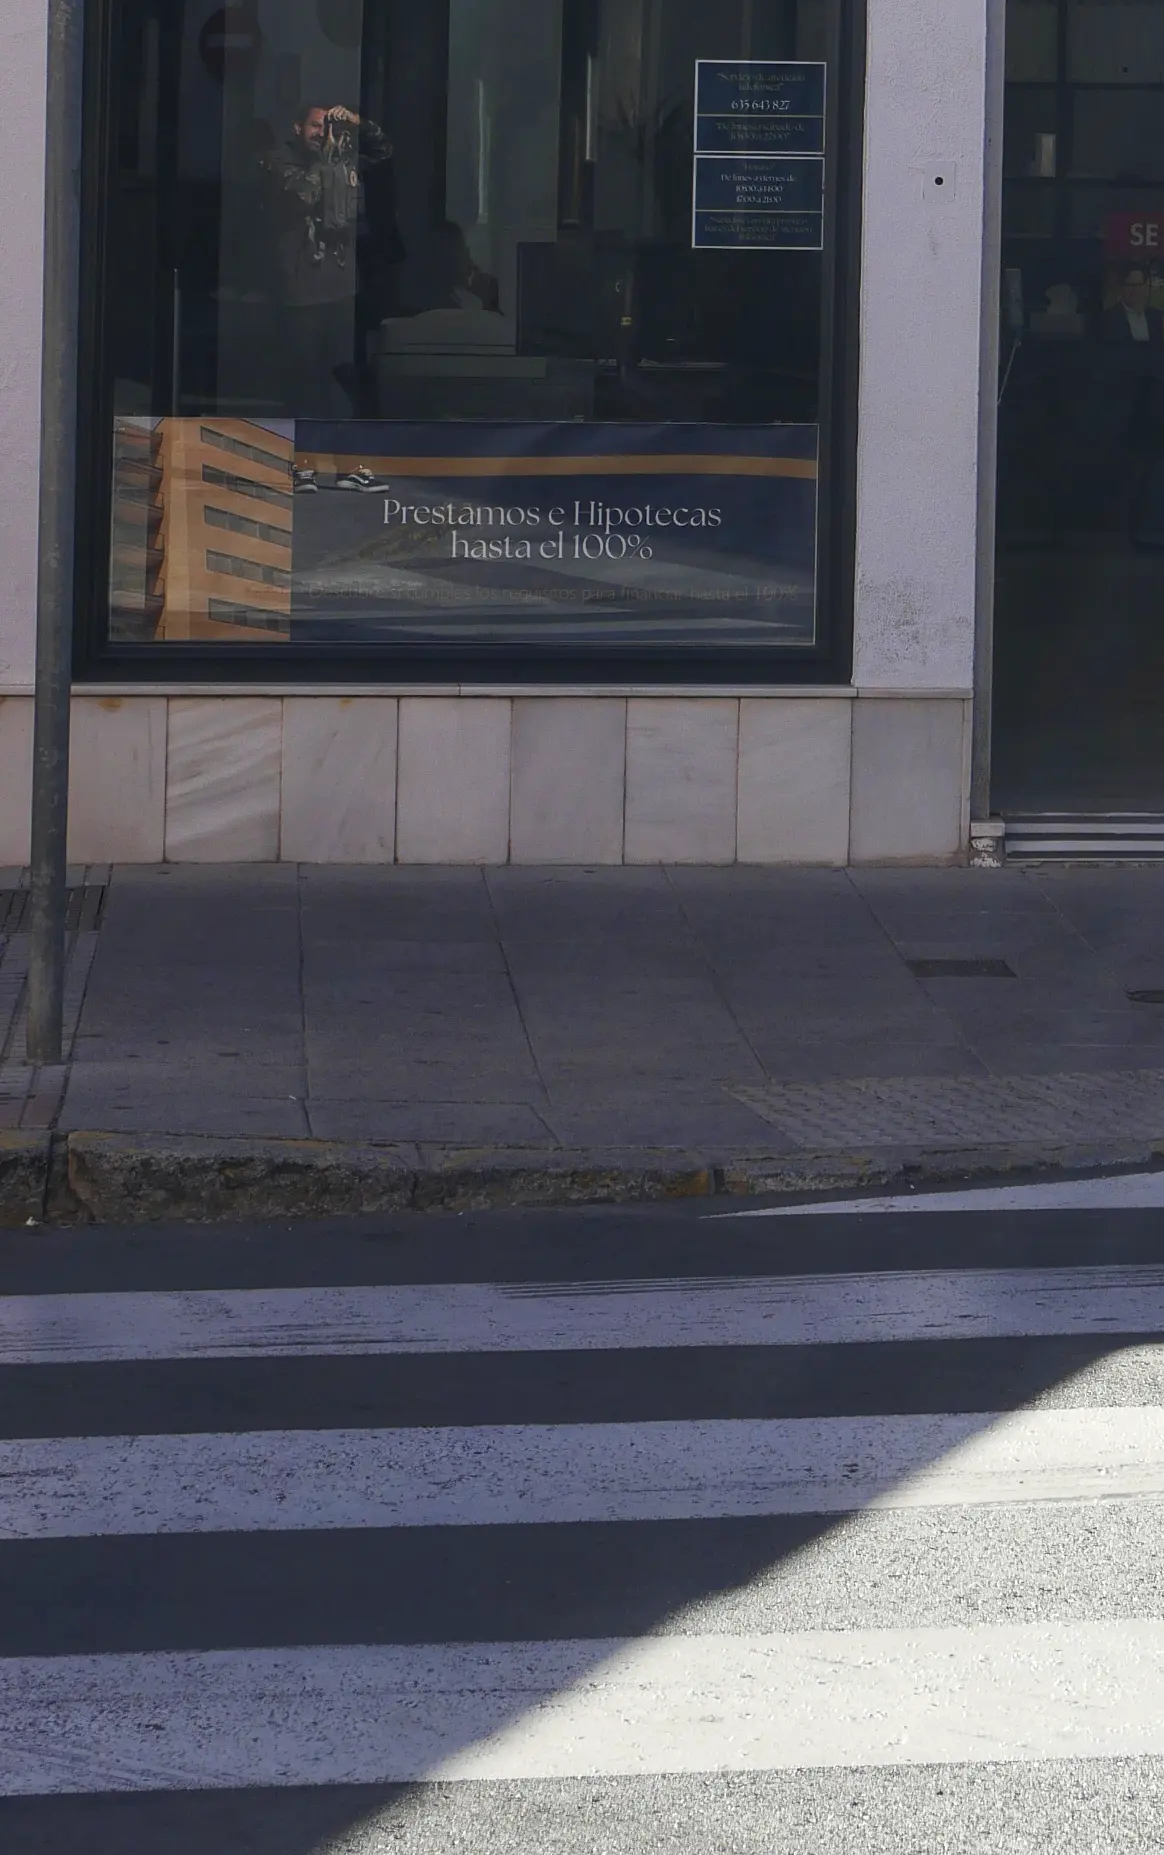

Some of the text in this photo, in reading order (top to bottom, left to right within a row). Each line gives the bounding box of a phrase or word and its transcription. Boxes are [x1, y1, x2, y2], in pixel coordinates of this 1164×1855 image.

[731, 99, 791, 111] 635 643 827
[1129, 222, 1159, 247] SE
[548, 506, 566, 527] e
[573, 500, 723, 535] Hipotecas
[451, 529, 654, 560] hasta el 100%
[582, 588, 616, 604] para
